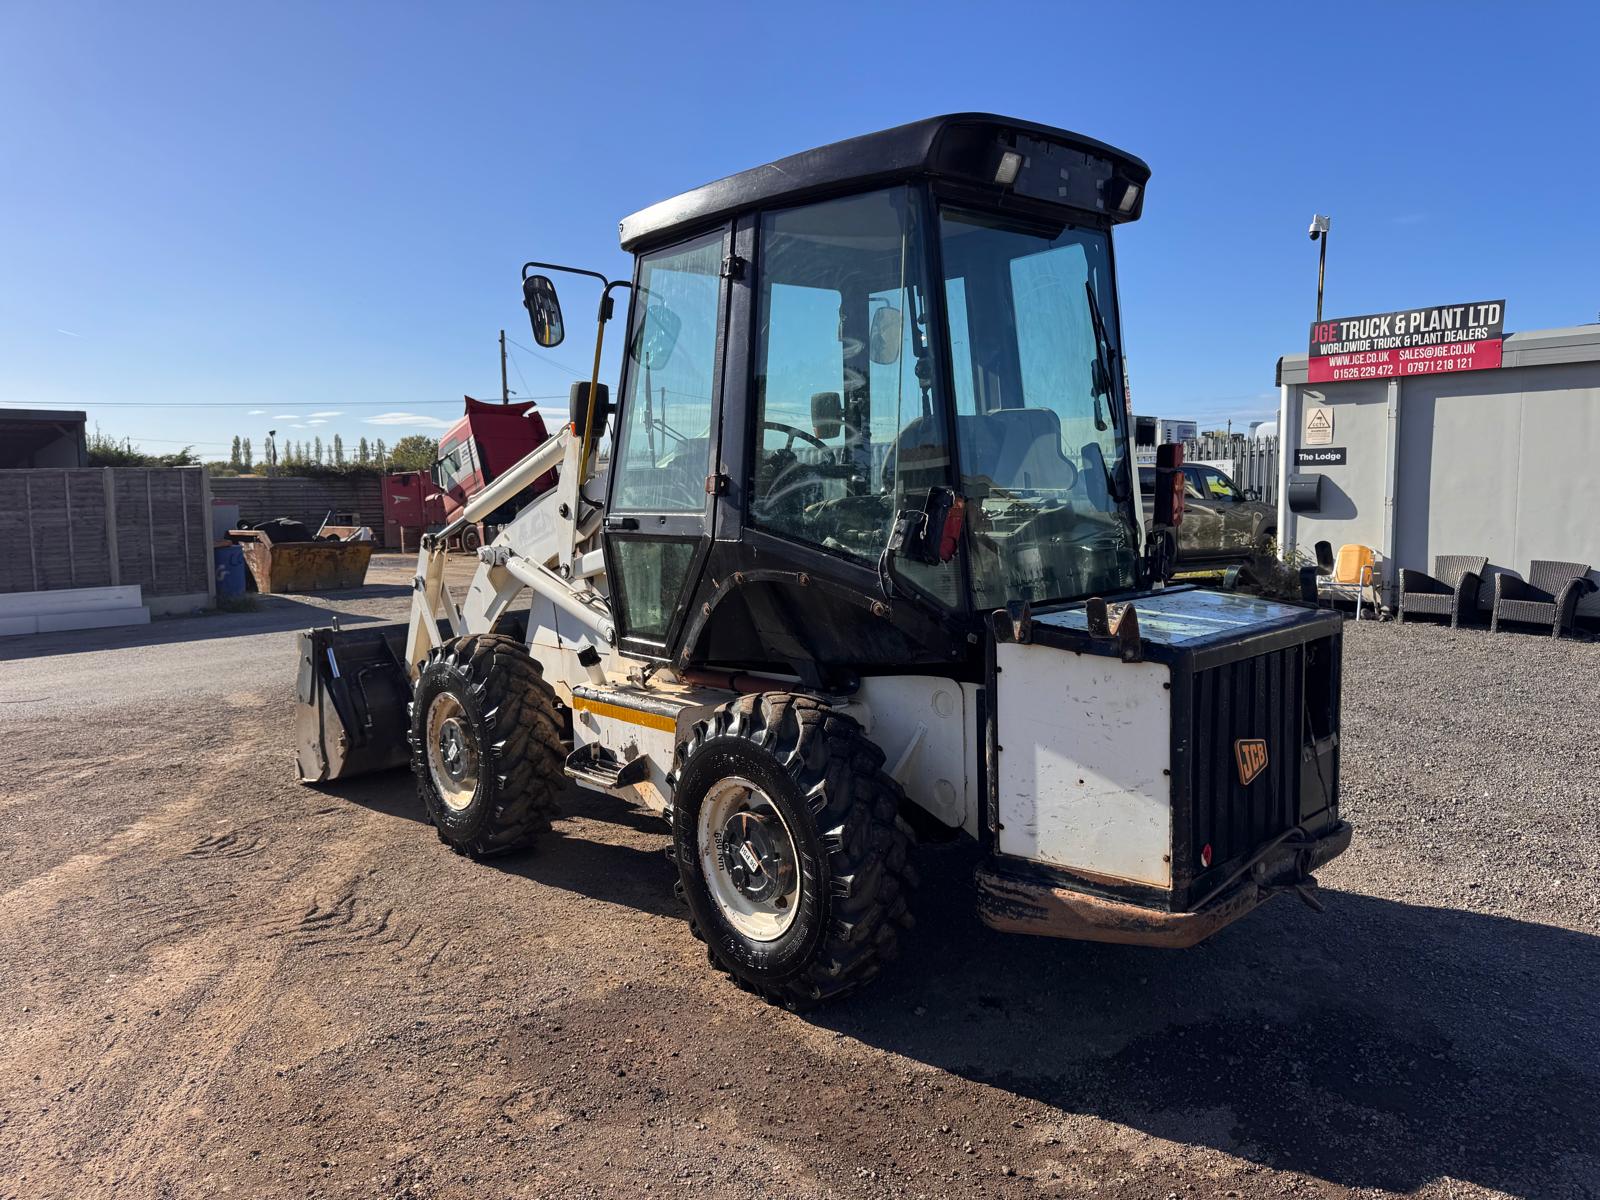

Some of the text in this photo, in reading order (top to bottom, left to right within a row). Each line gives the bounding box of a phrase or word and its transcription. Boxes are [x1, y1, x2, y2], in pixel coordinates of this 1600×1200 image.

[1312, 303, 1501, 344] JGE TRUCK & PLANT LTD
[1320, 327, 1488, 355] WORLDWIDE TRUCK & PLANT DEALERS
[1399, 343, 1476, 361] SALES@JGE.CO.UK
[1360, 366, 1376, 377] 229
[1377, 364, 1393, 375] 472
[1407, 359, 1434, 373] 07971
[1436, 358, 1453, 370] 218
[1456, 357, 1472, 368] 121
[1315, 452, 1341, 461] Lodge
[1241, 743, 1265, 779] JCB
